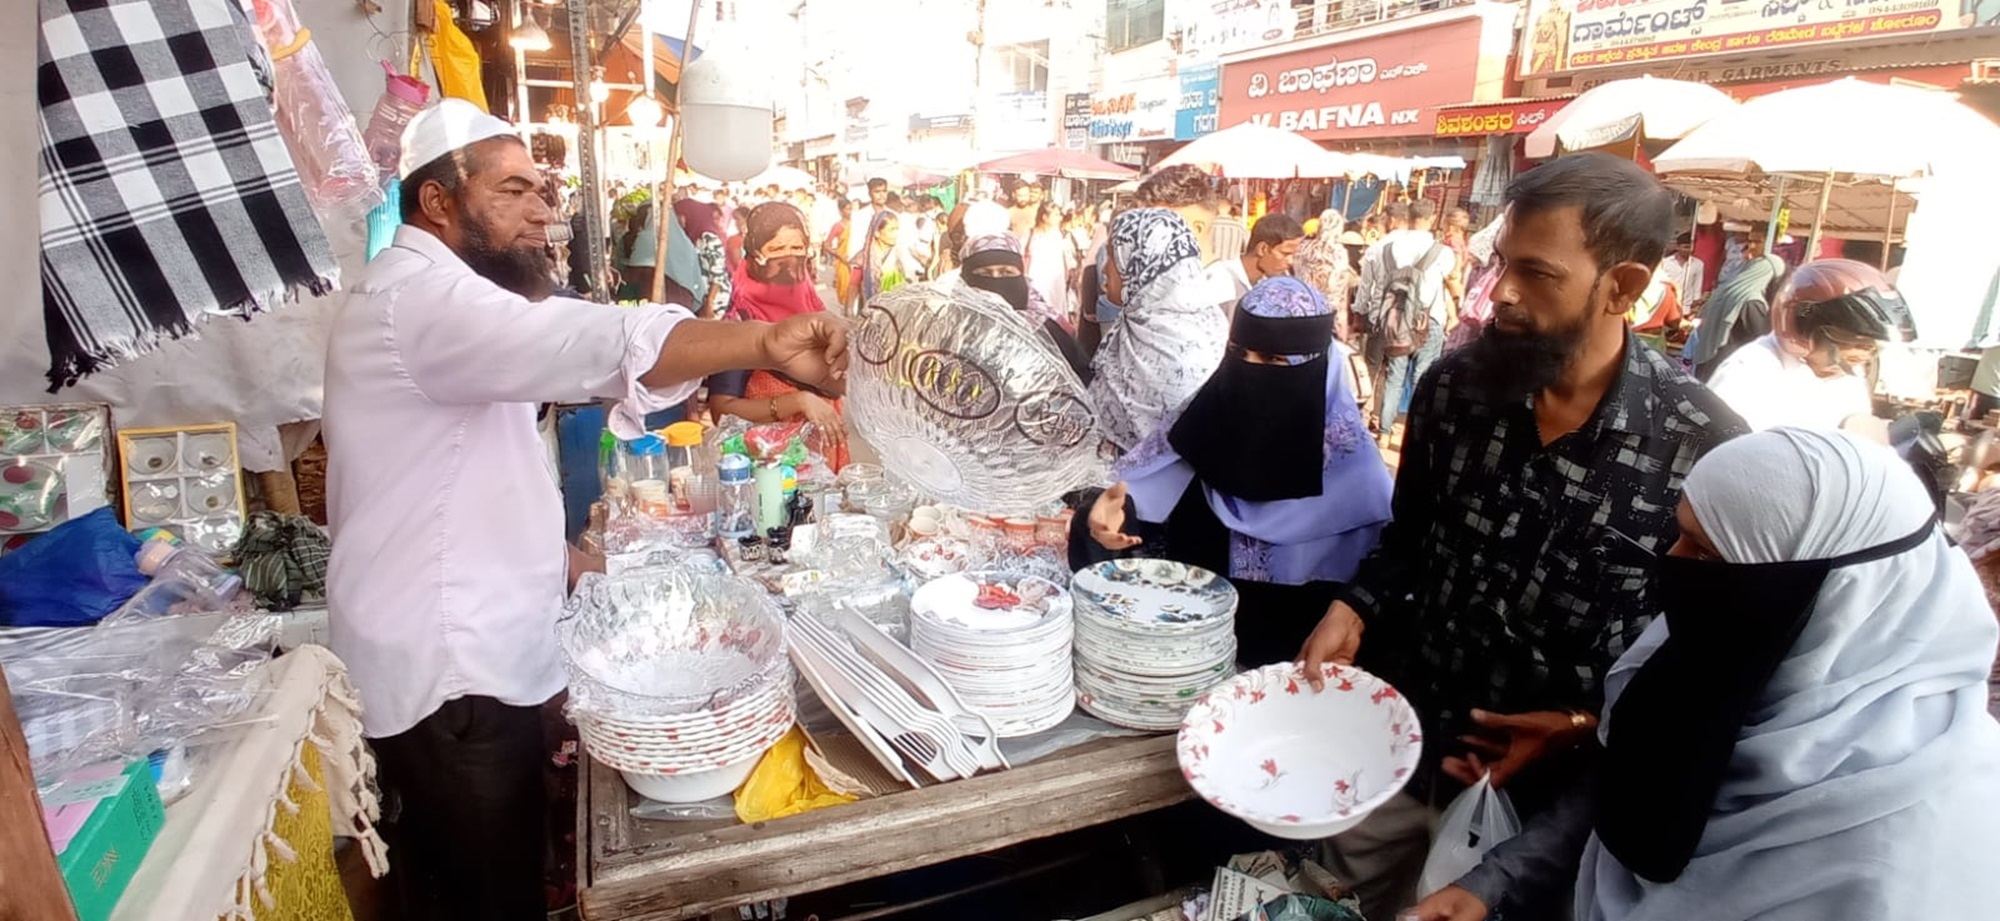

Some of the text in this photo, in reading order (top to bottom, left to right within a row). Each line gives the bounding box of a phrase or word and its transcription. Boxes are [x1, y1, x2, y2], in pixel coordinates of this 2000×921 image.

[1722, 60, 1840, 79] GARMENTS
[1279, 101, 1385, 131] BAFNA
[1391, 109, 1420, 125] NX
[1436, 110, 1514, 135] ಶಿವಶಂಕರ
